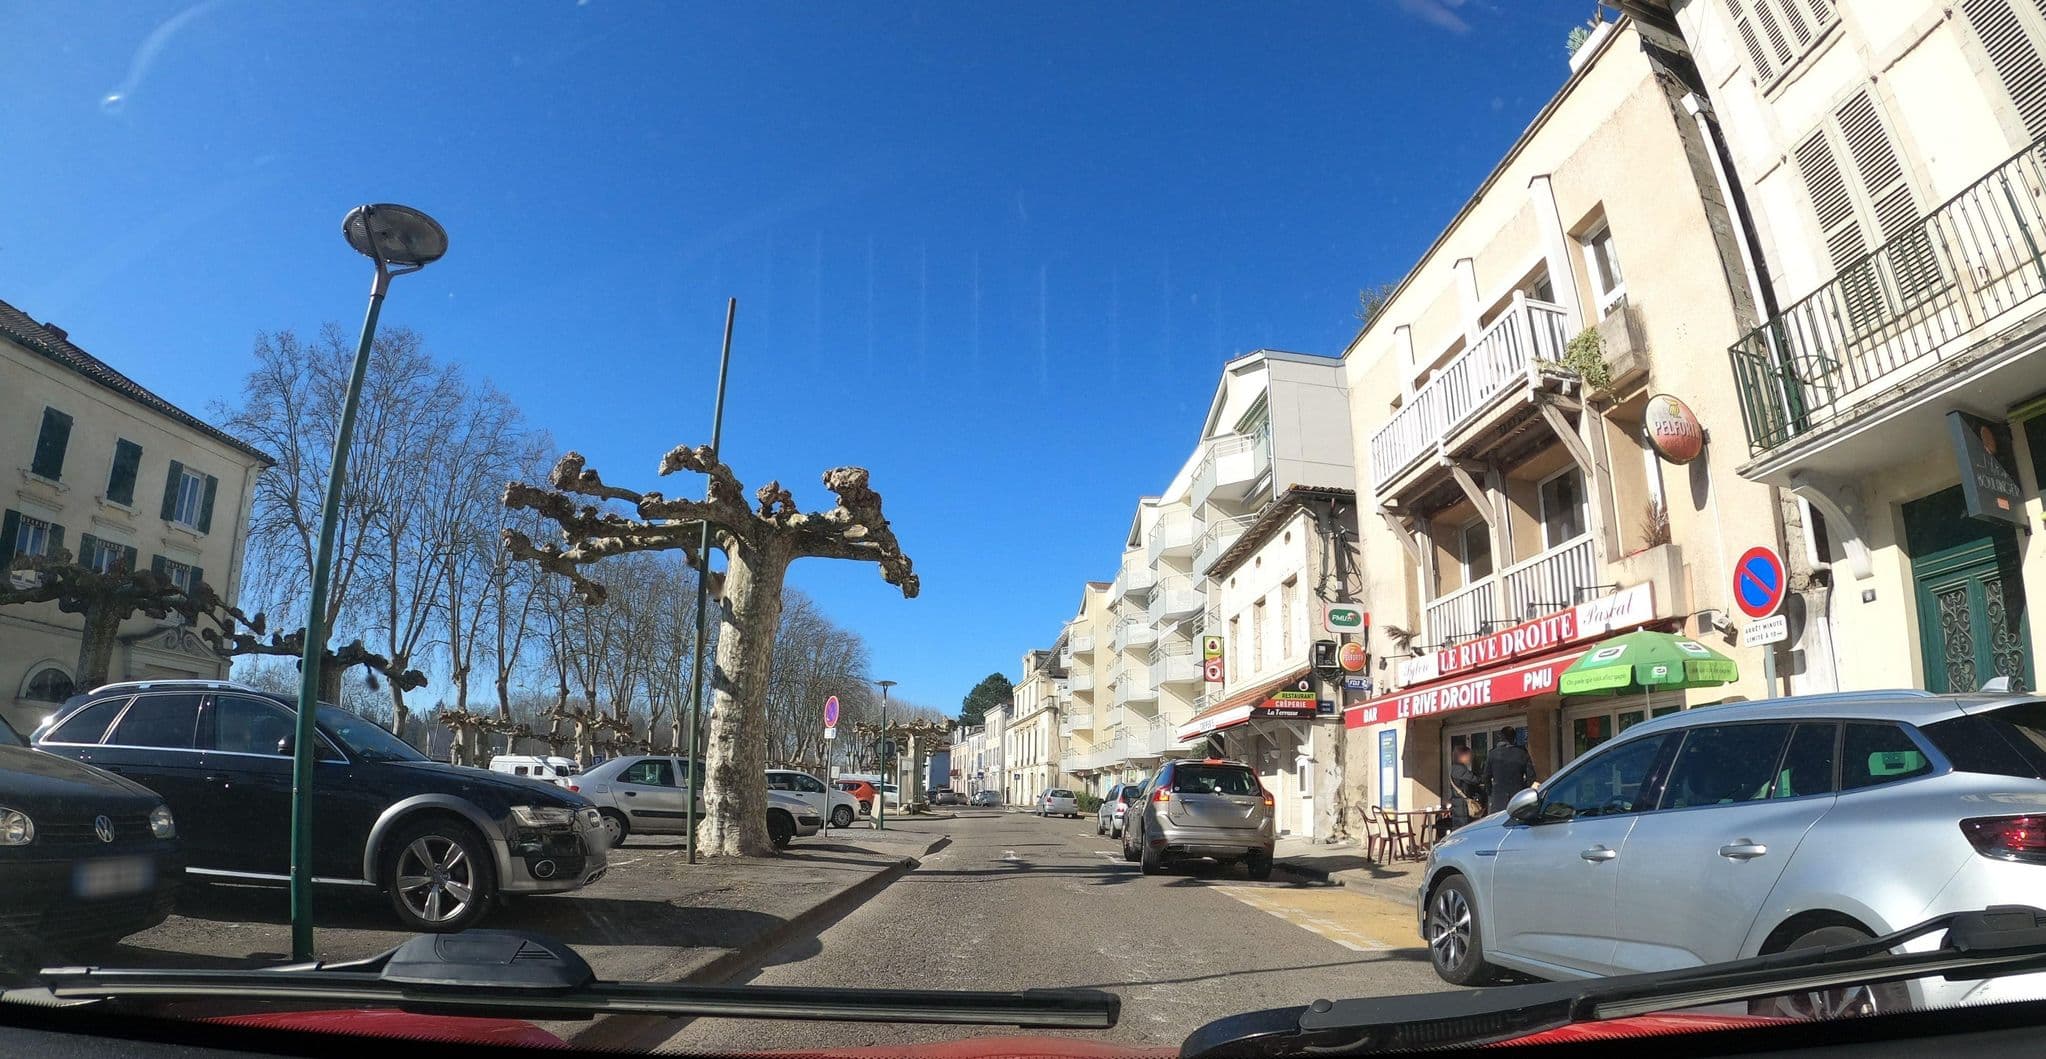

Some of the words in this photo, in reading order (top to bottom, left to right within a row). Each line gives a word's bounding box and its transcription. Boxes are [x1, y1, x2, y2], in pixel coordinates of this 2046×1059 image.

[1332, 614, 1348, 622] PMU
[1439, 649, 1458, 671] LE
[1460, 637, 1498, 667] RIVE
[1502, 612, 1574, 656] DROITE
[1583, 592, 1634, 625] Pascal
[1363, 707, 1378, 723] BAR
[1397, 697, 1410, 719] LE
[1412, 691, 1438, 716] RIVE
[1440, 680, 1491, 711] DROITE
[1523, 668, 1552, 692] PMU
